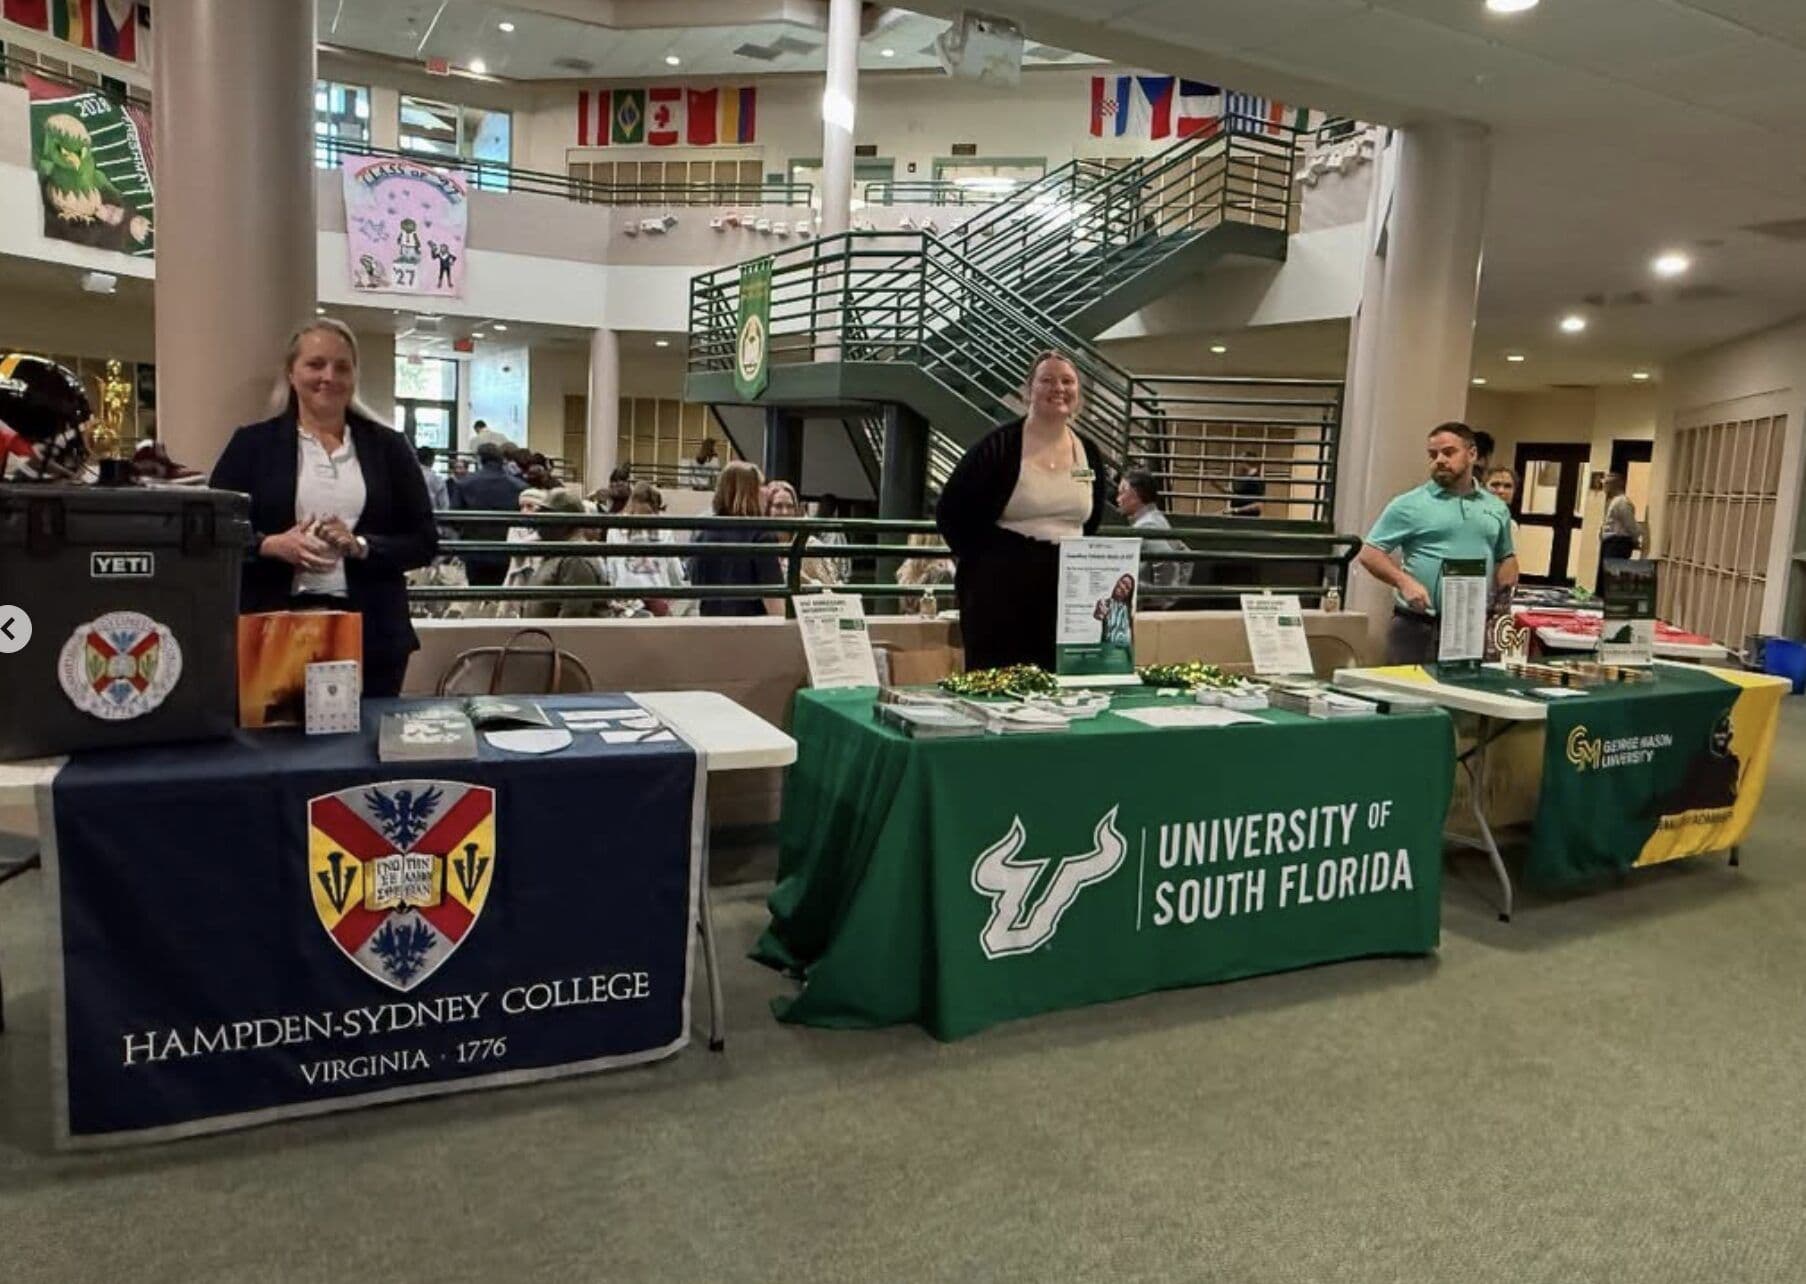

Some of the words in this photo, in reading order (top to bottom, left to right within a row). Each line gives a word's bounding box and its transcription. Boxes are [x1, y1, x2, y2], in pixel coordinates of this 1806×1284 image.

[362, 162, 404, 187] CLASS
[95, 556, 148, 573] YETI
[1158, 803, 1358, 868] UNIVERSITY
[1368, 801, 1394, 829] OF
[1154, 869, 1265, 925] SOUTH
[1278, 848, 1415, 908] FLORIDA
[500, 970, 651, 1016] COLLEGE
[299, 1047, 431, 1087] VIRGINIA
[456, 1035, 508, 1064] 1776
